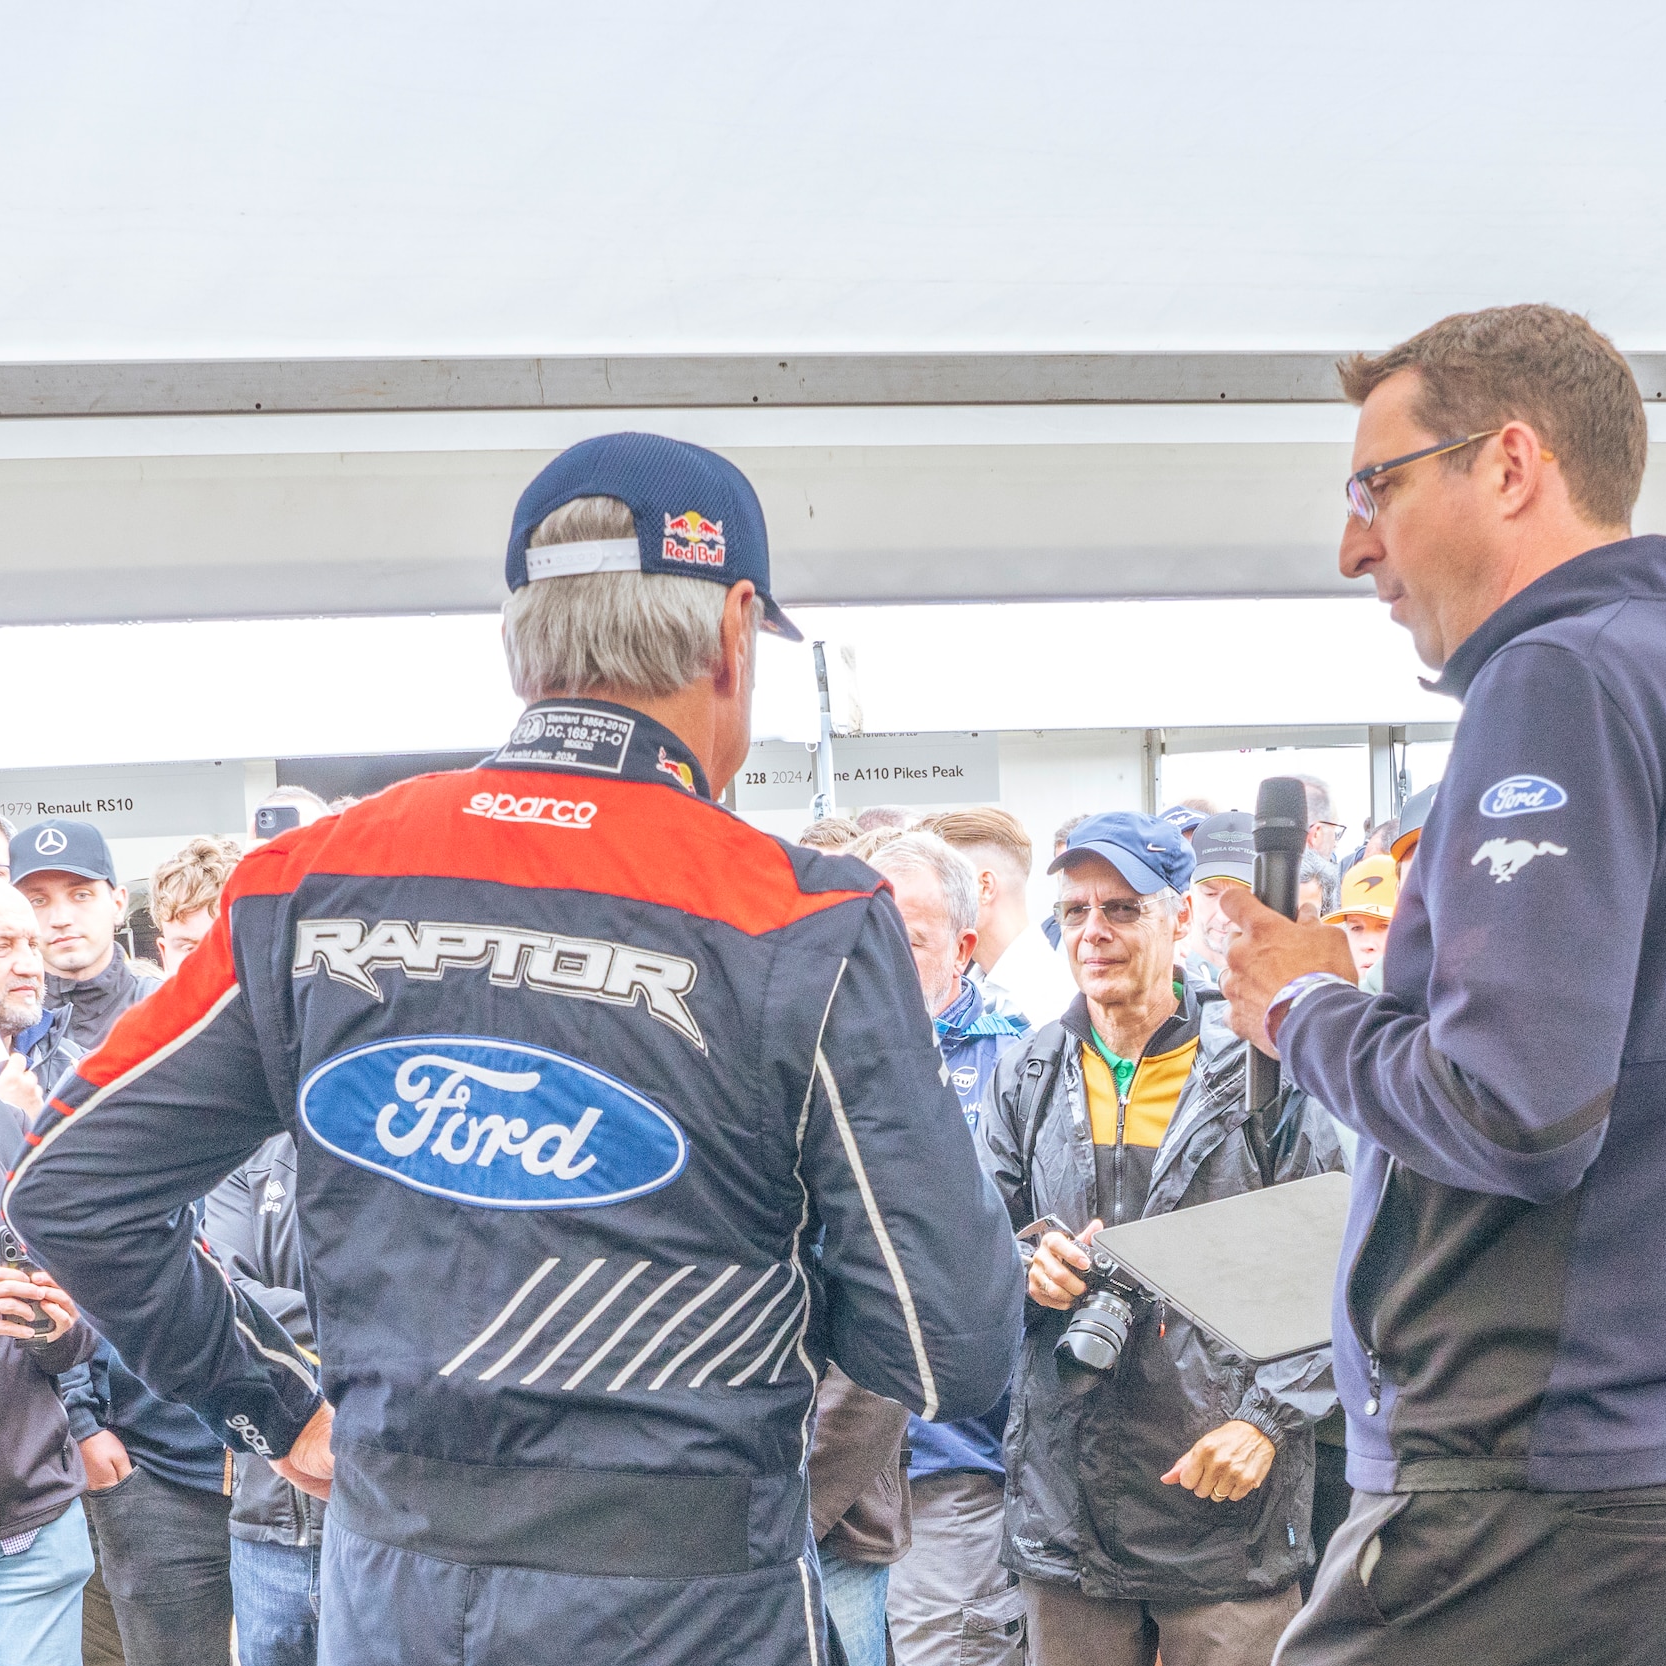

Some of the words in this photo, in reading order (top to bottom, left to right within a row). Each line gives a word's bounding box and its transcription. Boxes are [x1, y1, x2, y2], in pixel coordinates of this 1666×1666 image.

[664, 538, 694, 563] Red
[696, 543, 726, 567] Bull
[546, 714, 580, 725] Standard
[745, 772, 767, 784] 228
[771, 771, 802, 784] 2024
[854, 767, 890, 781] A110
[894, 766, 928, 779] Pikes
[932, 764, 965, 778] Peak
[0, 802, 33, 816] 1979
[37, 800, 93, 815] Renault
[96, 798, 134, 812] RS10
[463, 791, 598, 829] sparco
[293, 919, 709, 1058] RAPTOR
[376, 1054, 605, 1181] Ford
[225, 1413, 275, 1457] spar
